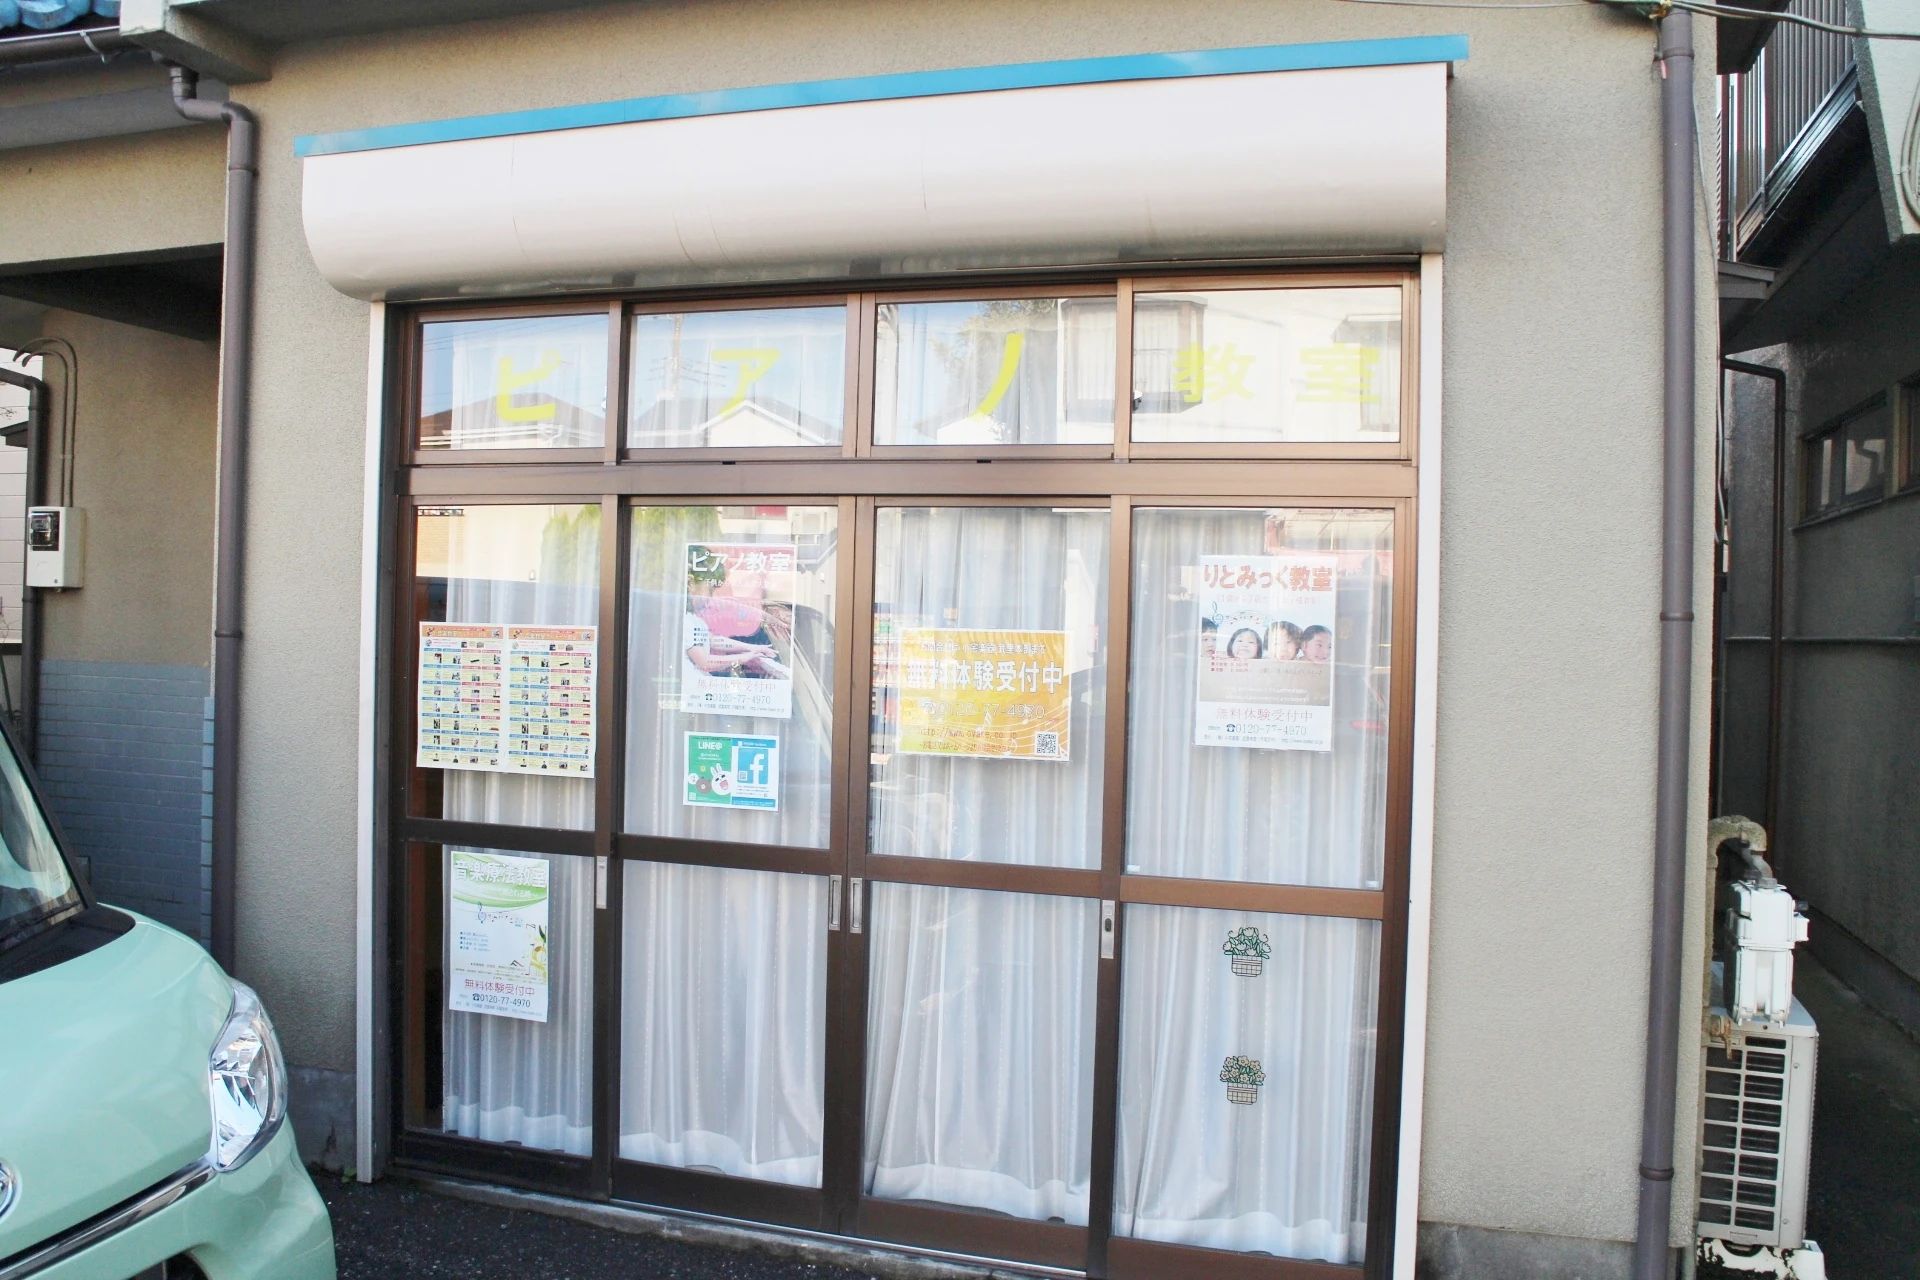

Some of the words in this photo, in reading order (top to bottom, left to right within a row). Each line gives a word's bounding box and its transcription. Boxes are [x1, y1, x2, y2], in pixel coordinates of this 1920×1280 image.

[692, 551, 791, 573] ピアノ教室
[1204, 565, 1333, 591] りとみっく教室
[907, 660, 1063, 694] 無料体験受付中
[464, 978, 536, 997] 無料体験受付中
[480, 993, 531, 1008] 0120-77-4970
